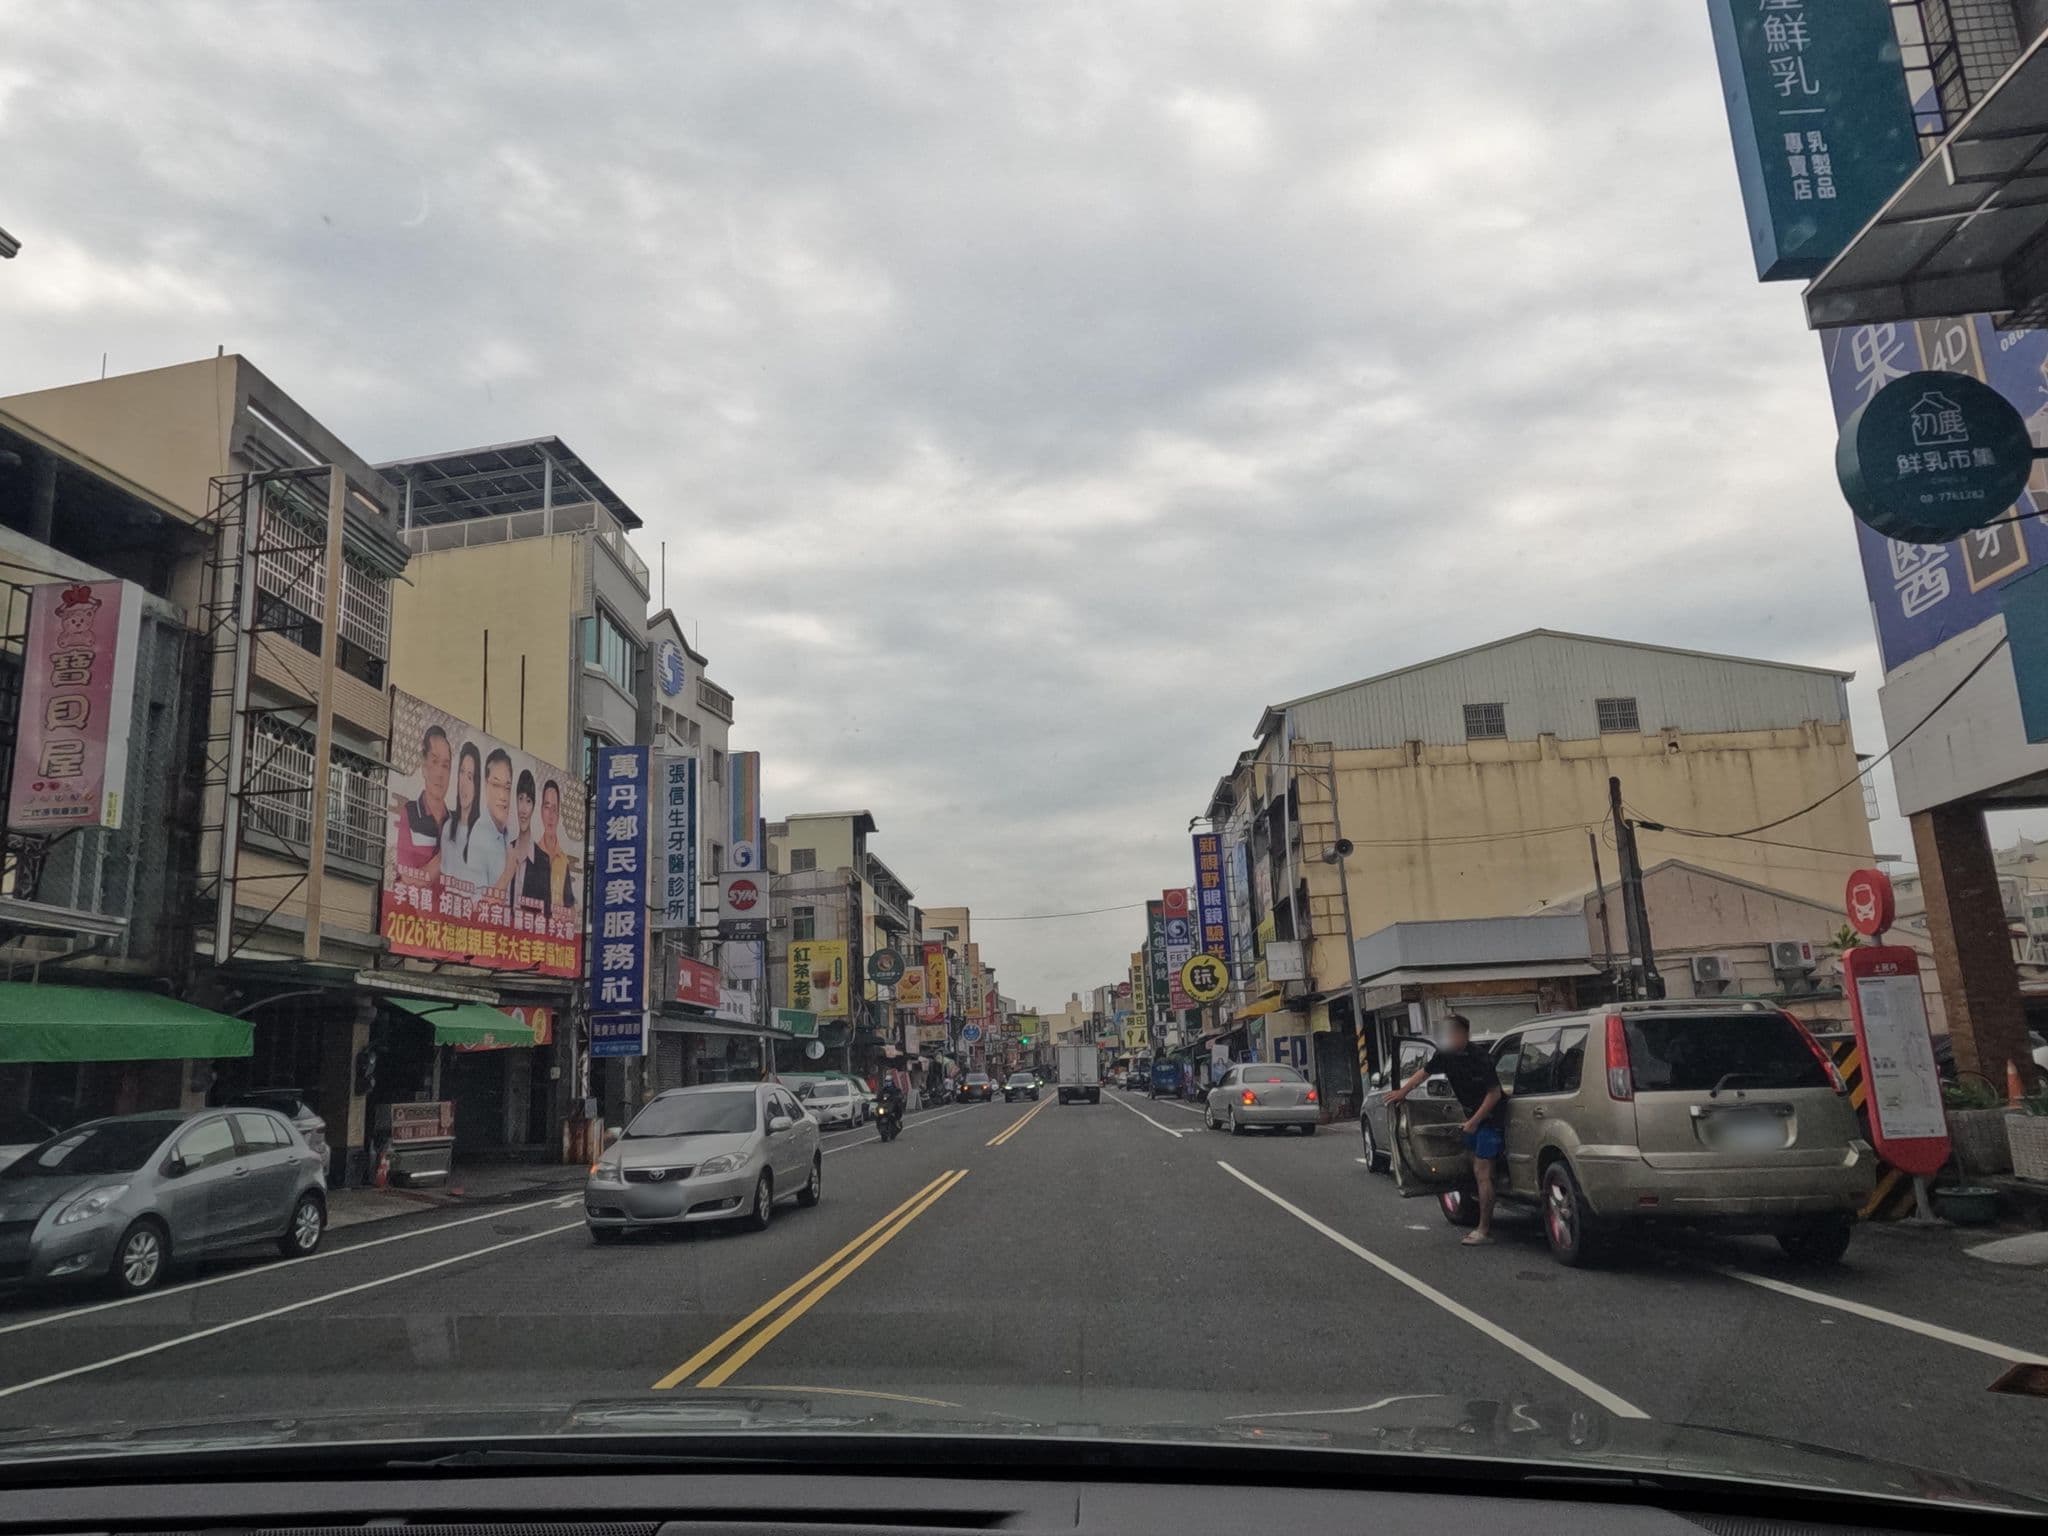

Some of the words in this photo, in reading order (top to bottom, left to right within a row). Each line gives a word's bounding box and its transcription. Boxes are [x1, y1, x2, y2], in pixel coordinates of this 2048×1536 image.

[1759, 0, 1820, 97] 鮮乳
[1784, 132, 1812, 200] 專賣店
[1806, 130, 1836, 199] 乳製品
[38, 650, 96, 778] 寶貝屋
[667, 764, 686, 920] 張信生牙醫診所
[728, 889, 760, 905] SYM
[1194, 969, 1212, 984] 玩
